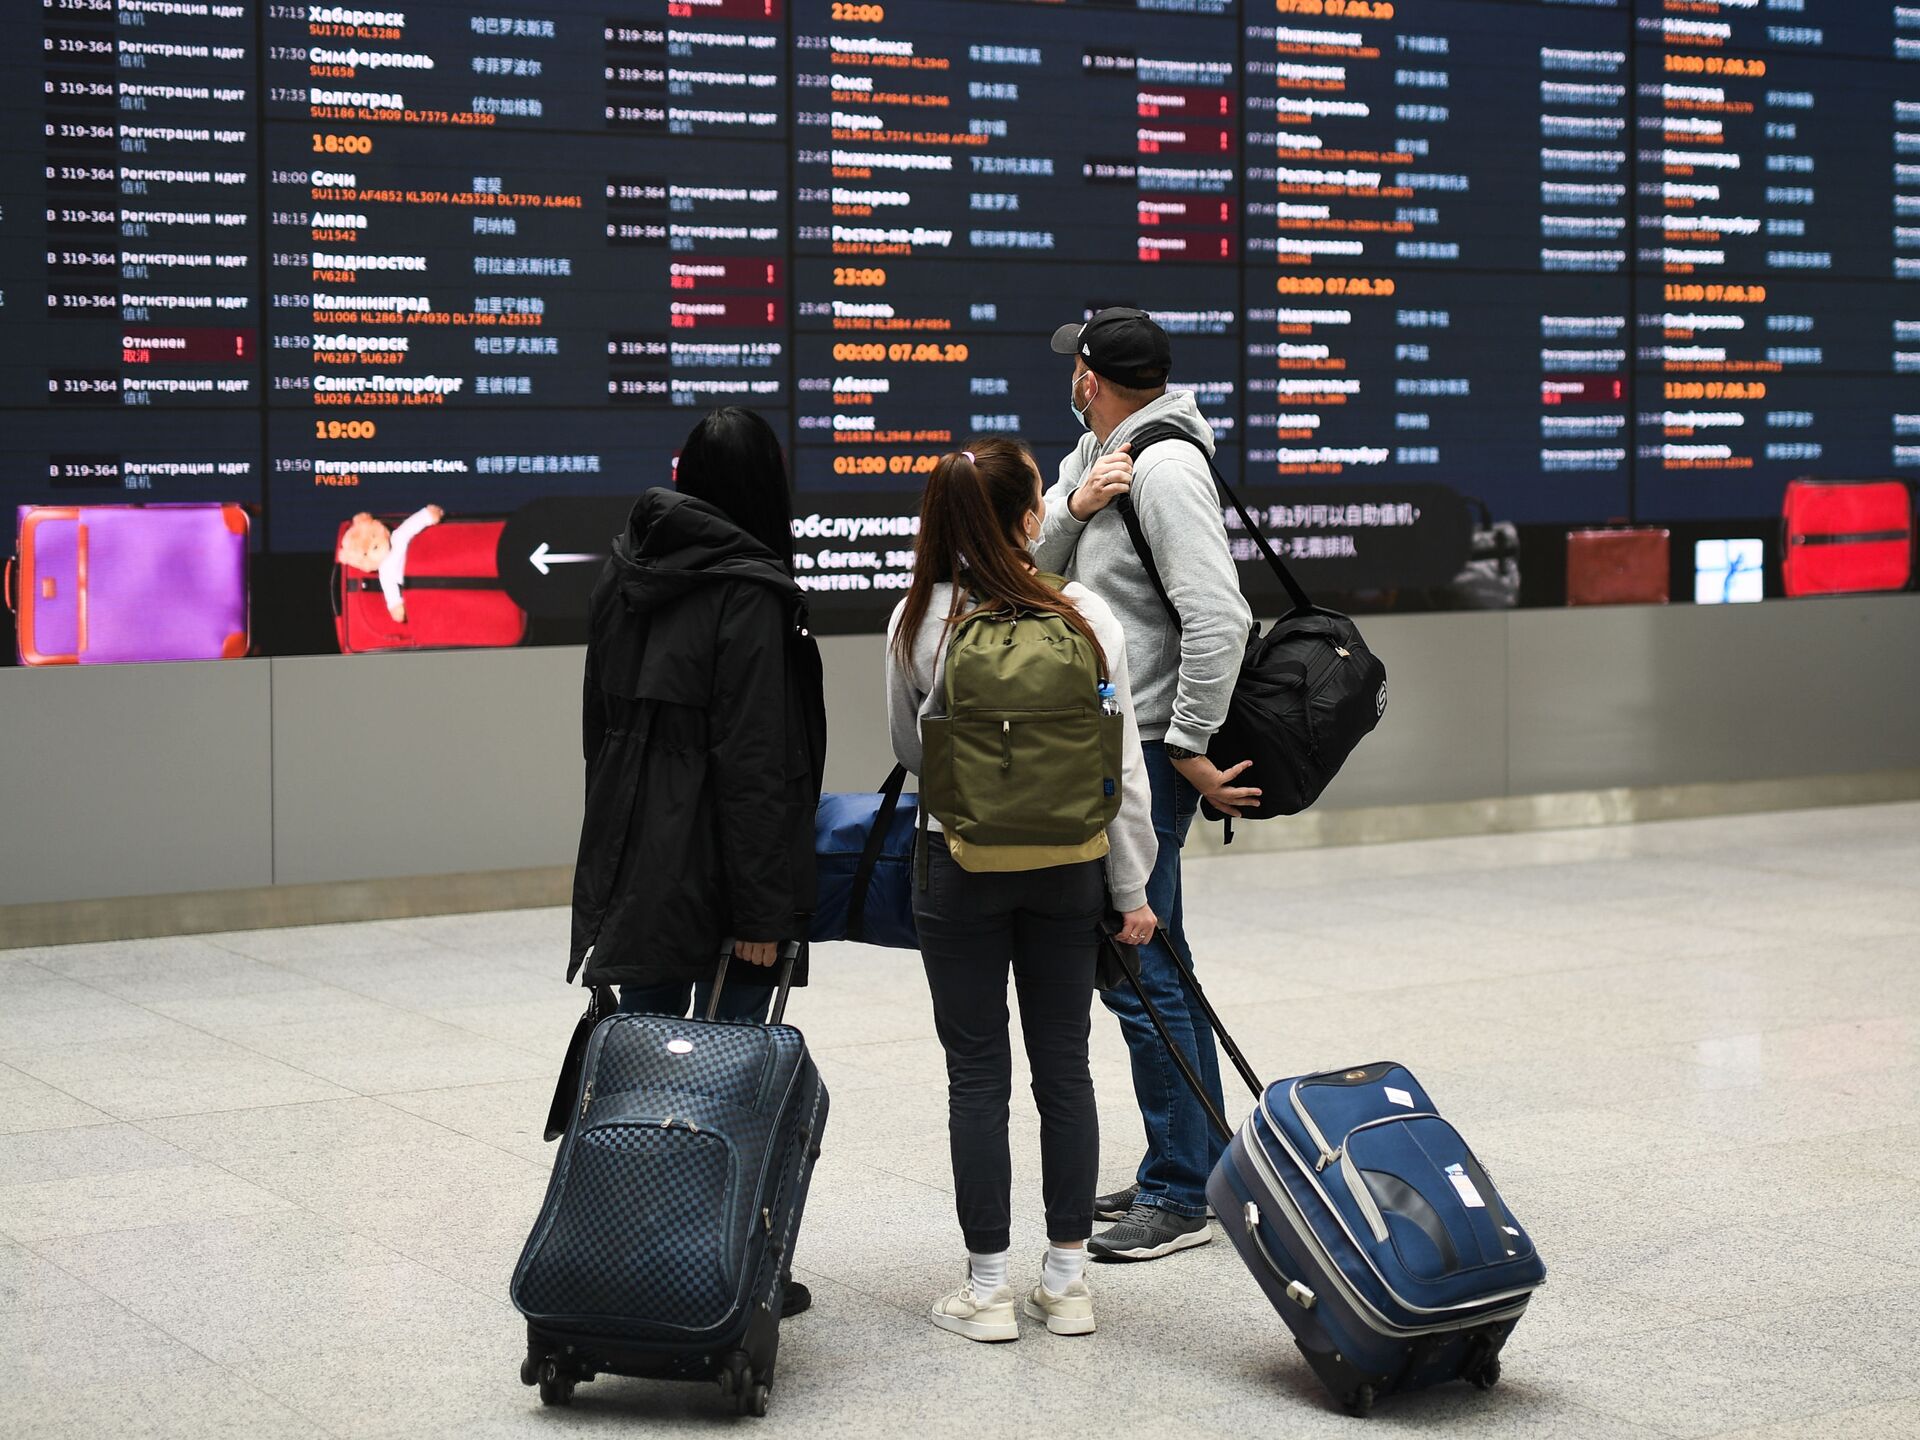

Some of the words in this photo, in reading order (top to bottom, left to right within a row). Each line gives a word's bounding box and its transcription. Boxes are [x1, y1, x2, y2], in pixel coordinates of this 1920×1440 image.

[118, 0, 208, 16] Регистрация
[212, 6, 243, 17] идет
[270, 5, 305, 19] 17:15
[832, 3, 883, 22] 22:00
[309, 6, 404, 27] Хабаровск
[60, 40, 112, 52] 319-364
[119, 40, 208, 57] Регистрация
[213, 48, 244, 59] идет
[271, 47, 306, 60] 17:30
[310, 48, 434, 69] Симферополь
[61, 83, 112, 95] 319-364
[119, 83, 209, 100] Регистрация
[214, 89, 244, 101] идет
[271, 88, 306, 101] 17:35
[311, 88, 403, 110] Волгоград
[62, 125, 113, 137] 319-364
[120, 126, 209, 141] Регистрация
[214, 131, 245, 142] идет
[313, 134, 372, 153] 18:00
[62, 168, 113, 179] 319-364
[121, 168, 210, 183] Регистрация
[215, 173, 246, 184] идет
[272, 171, 308, 184] 18:00
[311, 171, 355, 187] Сочи
[63, 210, 114, 222] 319-364
[121, 210, 211, 224] Регистрация
[215, 214, 246, 226] идет
[273, 212, 308, 225] 18:15
[312, 212, 367, 228] Анапа
[64, 253, 115, 264] 319-364
[122, 252, 211, 265] Регистрация
[216, 256, 247, 267] идет
[273, 253, 308, 266] 18:25
[313, 253, 426, 271] Владивосток
[834, 268, 885, 286] 23:00
[64, 296, 115, 306] 319-364
[123, 294, 212, 308] Регистрация
[217, 297, 247, 309] идет
[274, 295, 310, 307] 18:30
[313, 294, 430, 314] Калининград
[123, 337, 185, 348] Отменен
[274, 336, 310, 348] 18:30
[313, 334, 408, 353] Хабаровск
[123, 350, 149, 362] 取消
[833, 344, 886, 361] 00:00
[889, 344, 968, 361] 07.06.20
[66, 380, 116, 391] 319-364
[123, 378, 213, 392] Регистрация
[218, 380, 248, 392] идет
[275, 377, 310, 389] 18:45
[314, 375, 462, 394] Санкт-Петербург
[317, 421, 375, 438] 19:00
[66, 465, 117, 476] 319-364
[124, 463, 214, 476] Регистрация
[219, 463, 249, 474] идет
[276, 459, 311, 471] 19:50
[315, 459, 467, 476] Петропавловск-Кмч.
[834, 456, 886, 474] 01:00
[818, 549, 882, 569] багаж,
